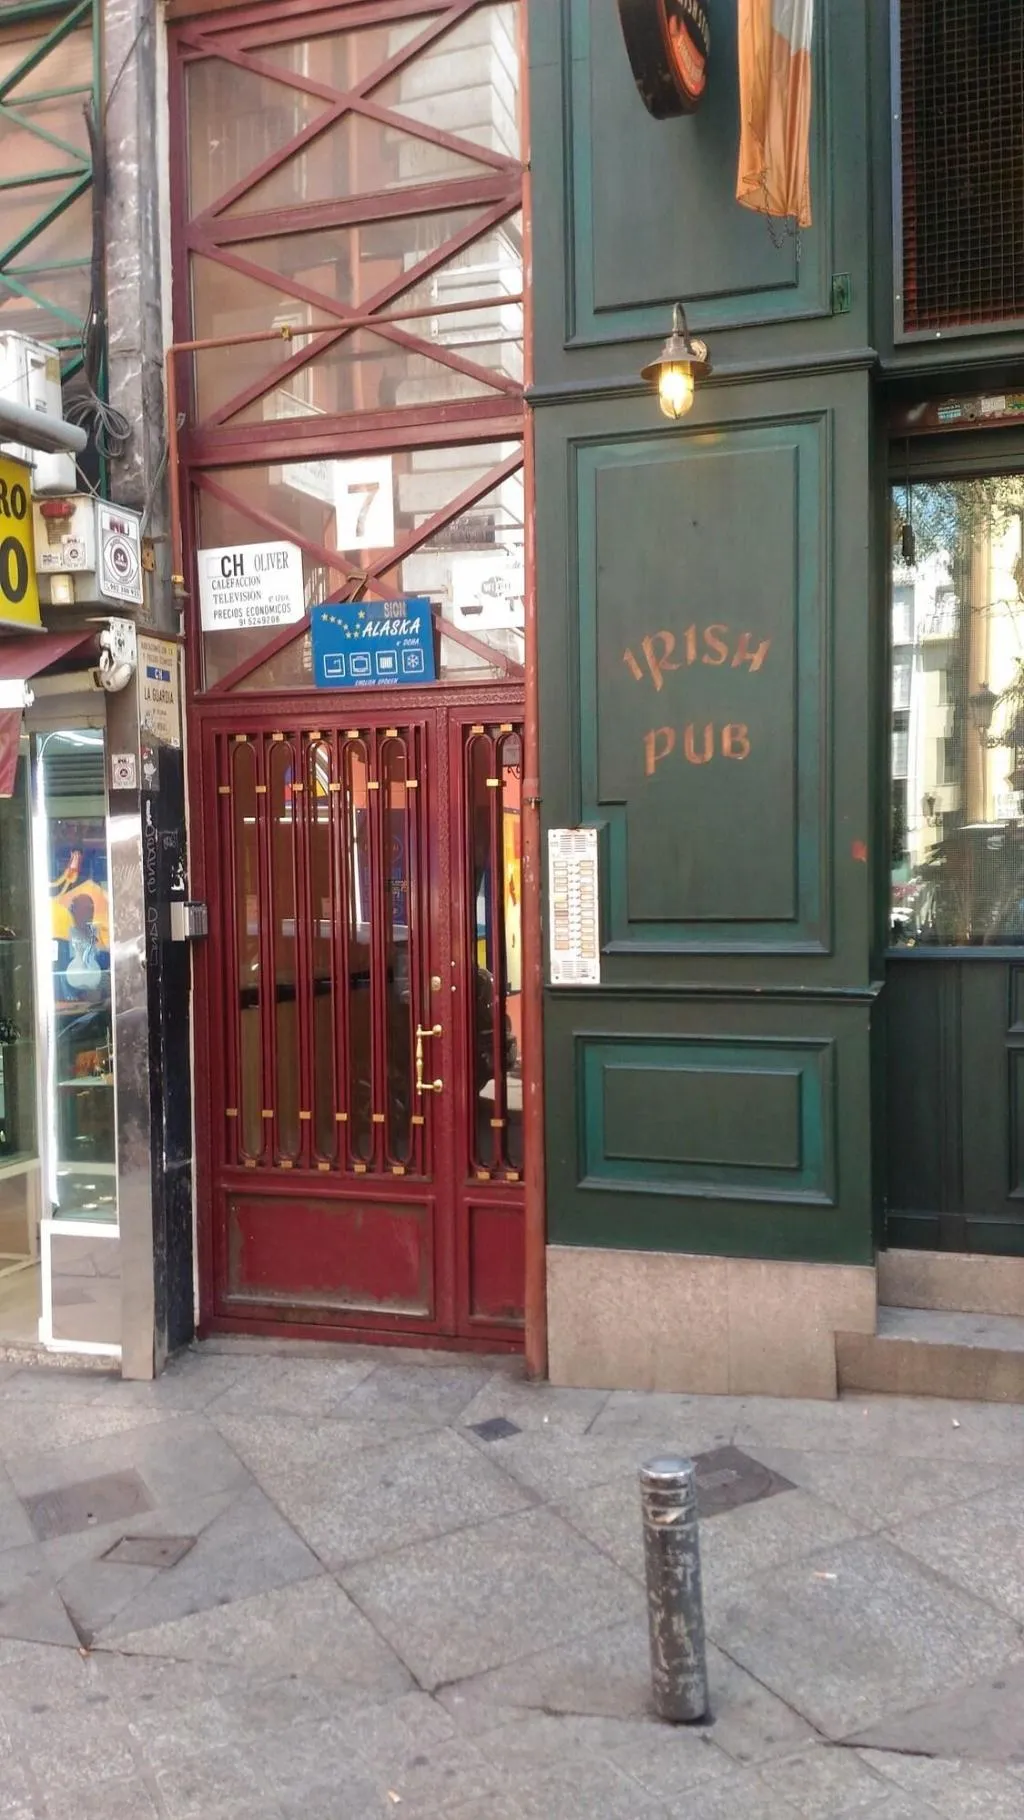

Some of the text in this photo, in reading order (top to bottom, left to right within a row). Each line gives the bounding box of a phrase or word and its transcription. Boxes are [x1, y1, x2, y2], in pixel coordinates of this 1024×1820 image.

[347, 482, 380, 538] 7
[220, 551, 289, 578] CH OLIVER
[211, 575, 261, 591] CALEFACCION
[212, 590, 262, 604] TELEVISION
[213, 603, 292, 620] PRECIOS ECONOMICOS
[361, 617, 421, 638] ALASKA
[623, 623, 772, 692] IRISH
[152, 687, 175, 704] GUARDIA
[643, 721, 752, 776] PUB
